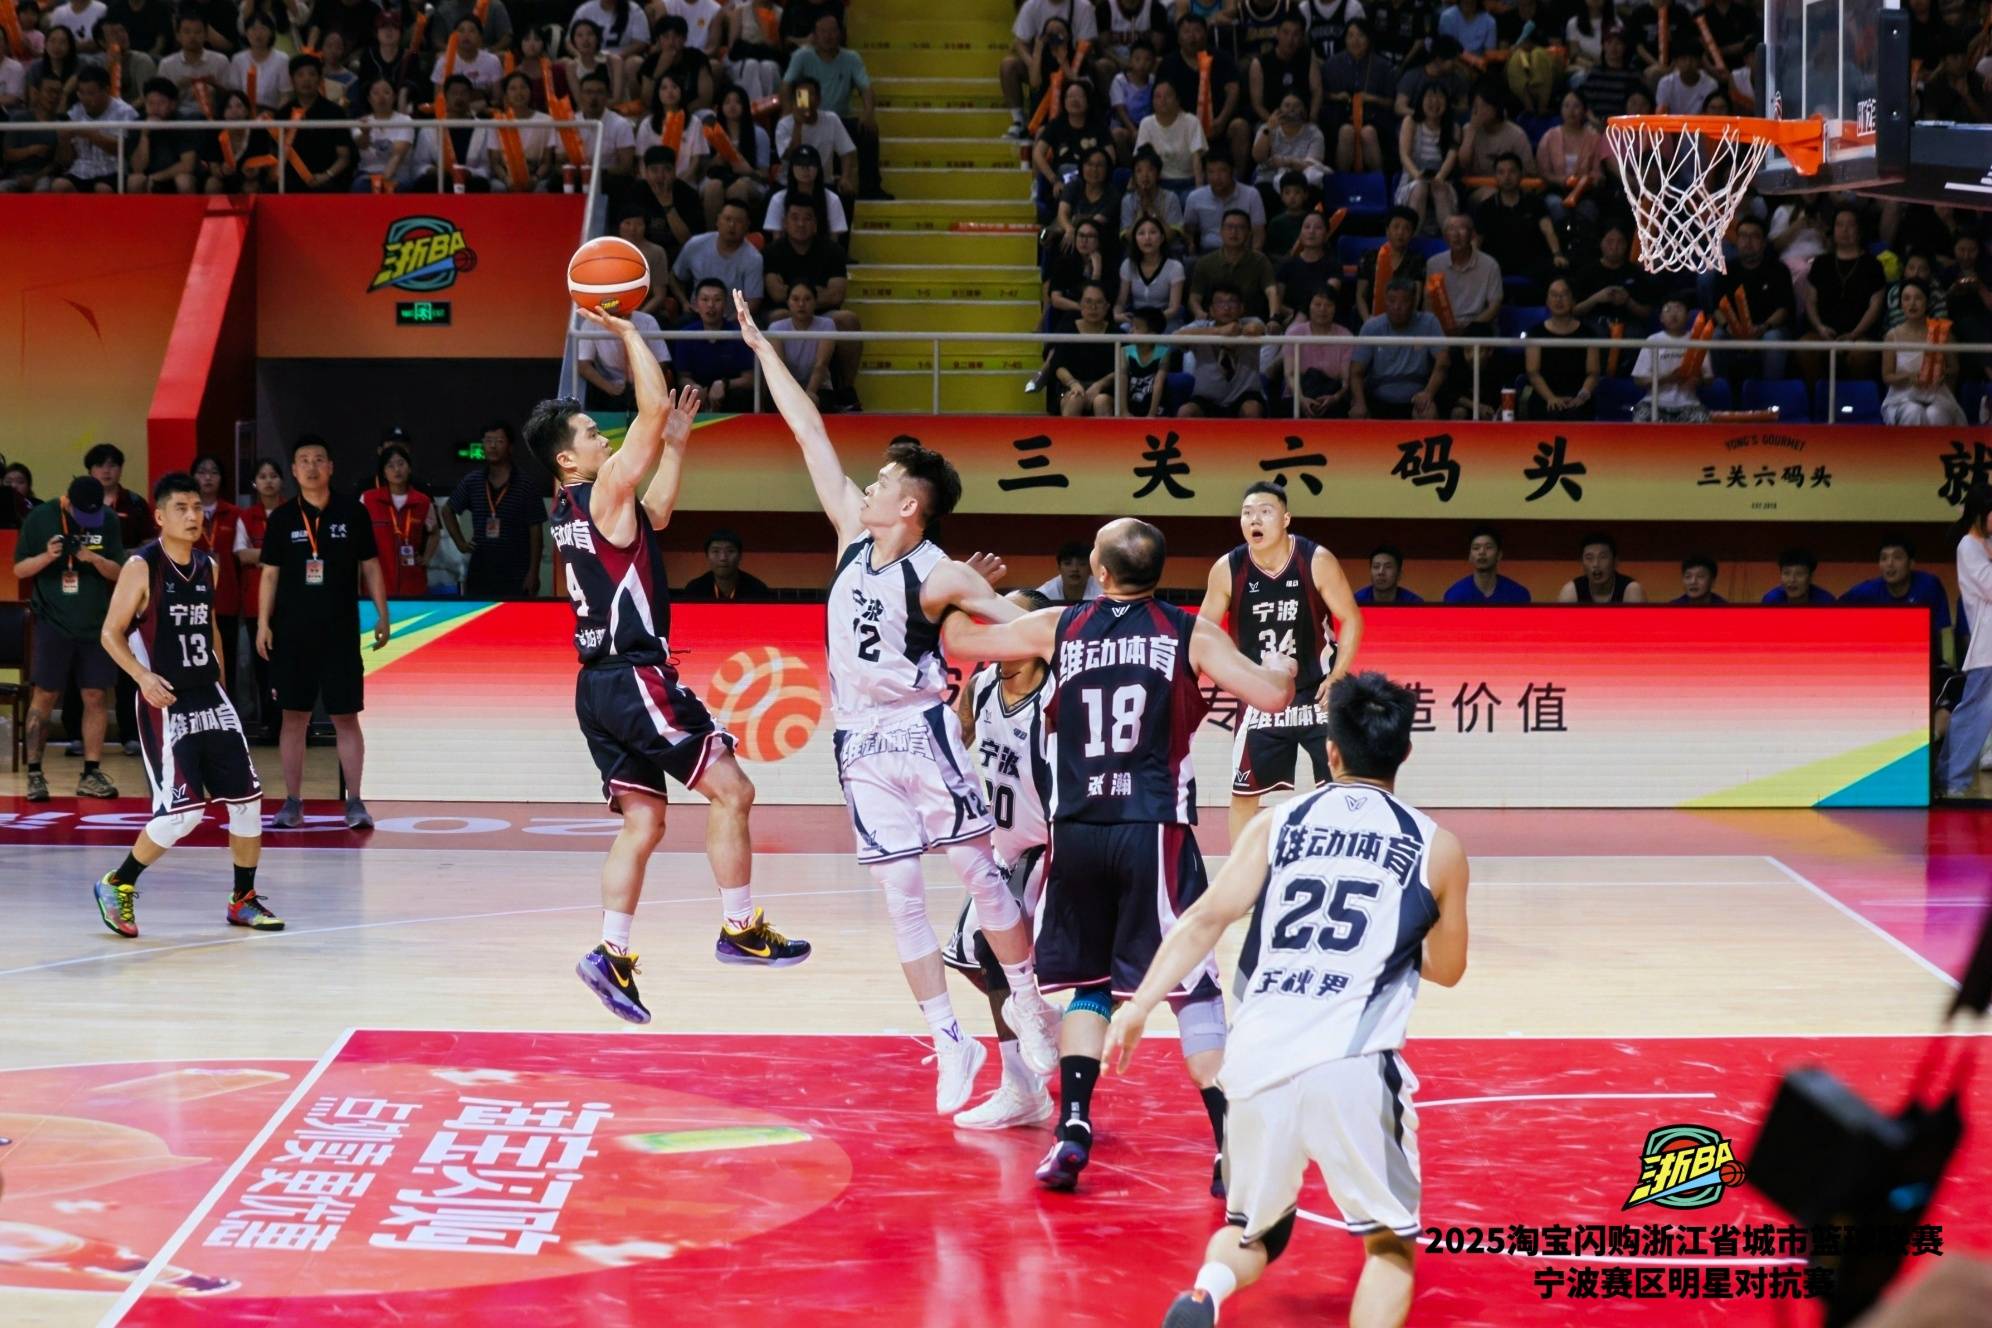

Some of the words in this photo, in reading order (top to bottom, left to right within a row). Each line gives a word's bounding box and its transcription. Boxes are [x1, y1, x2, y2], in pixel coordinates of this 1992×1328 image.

[373, 231, 466, 286] 浙BA
[998, 431, 1587, 502] 三关六码头
[1697, 464, 1832, 488] 三关六码头
[551, 519, 597, 555] 动体育
[565, 562, 589, 617] 4
[1252, 599, 1299, 623] 宁波
[169, 603, 208, 626] 宁波
[178, 633, 208, 668] 13
[1058, 634, 1179, 688] 维动体育
[1258, 628, 1297, 655] 34
[169, 703, 243, 747] 维动体育
[1081, 684, 1147, 758] 18
[979, 738, 1021, 780] 宁波
[1273, 824, 1424, 889] 维动体育
[1270, 877, 1383, 953] 25
[368, 1096, 615, 1256] 淘宝闪购
